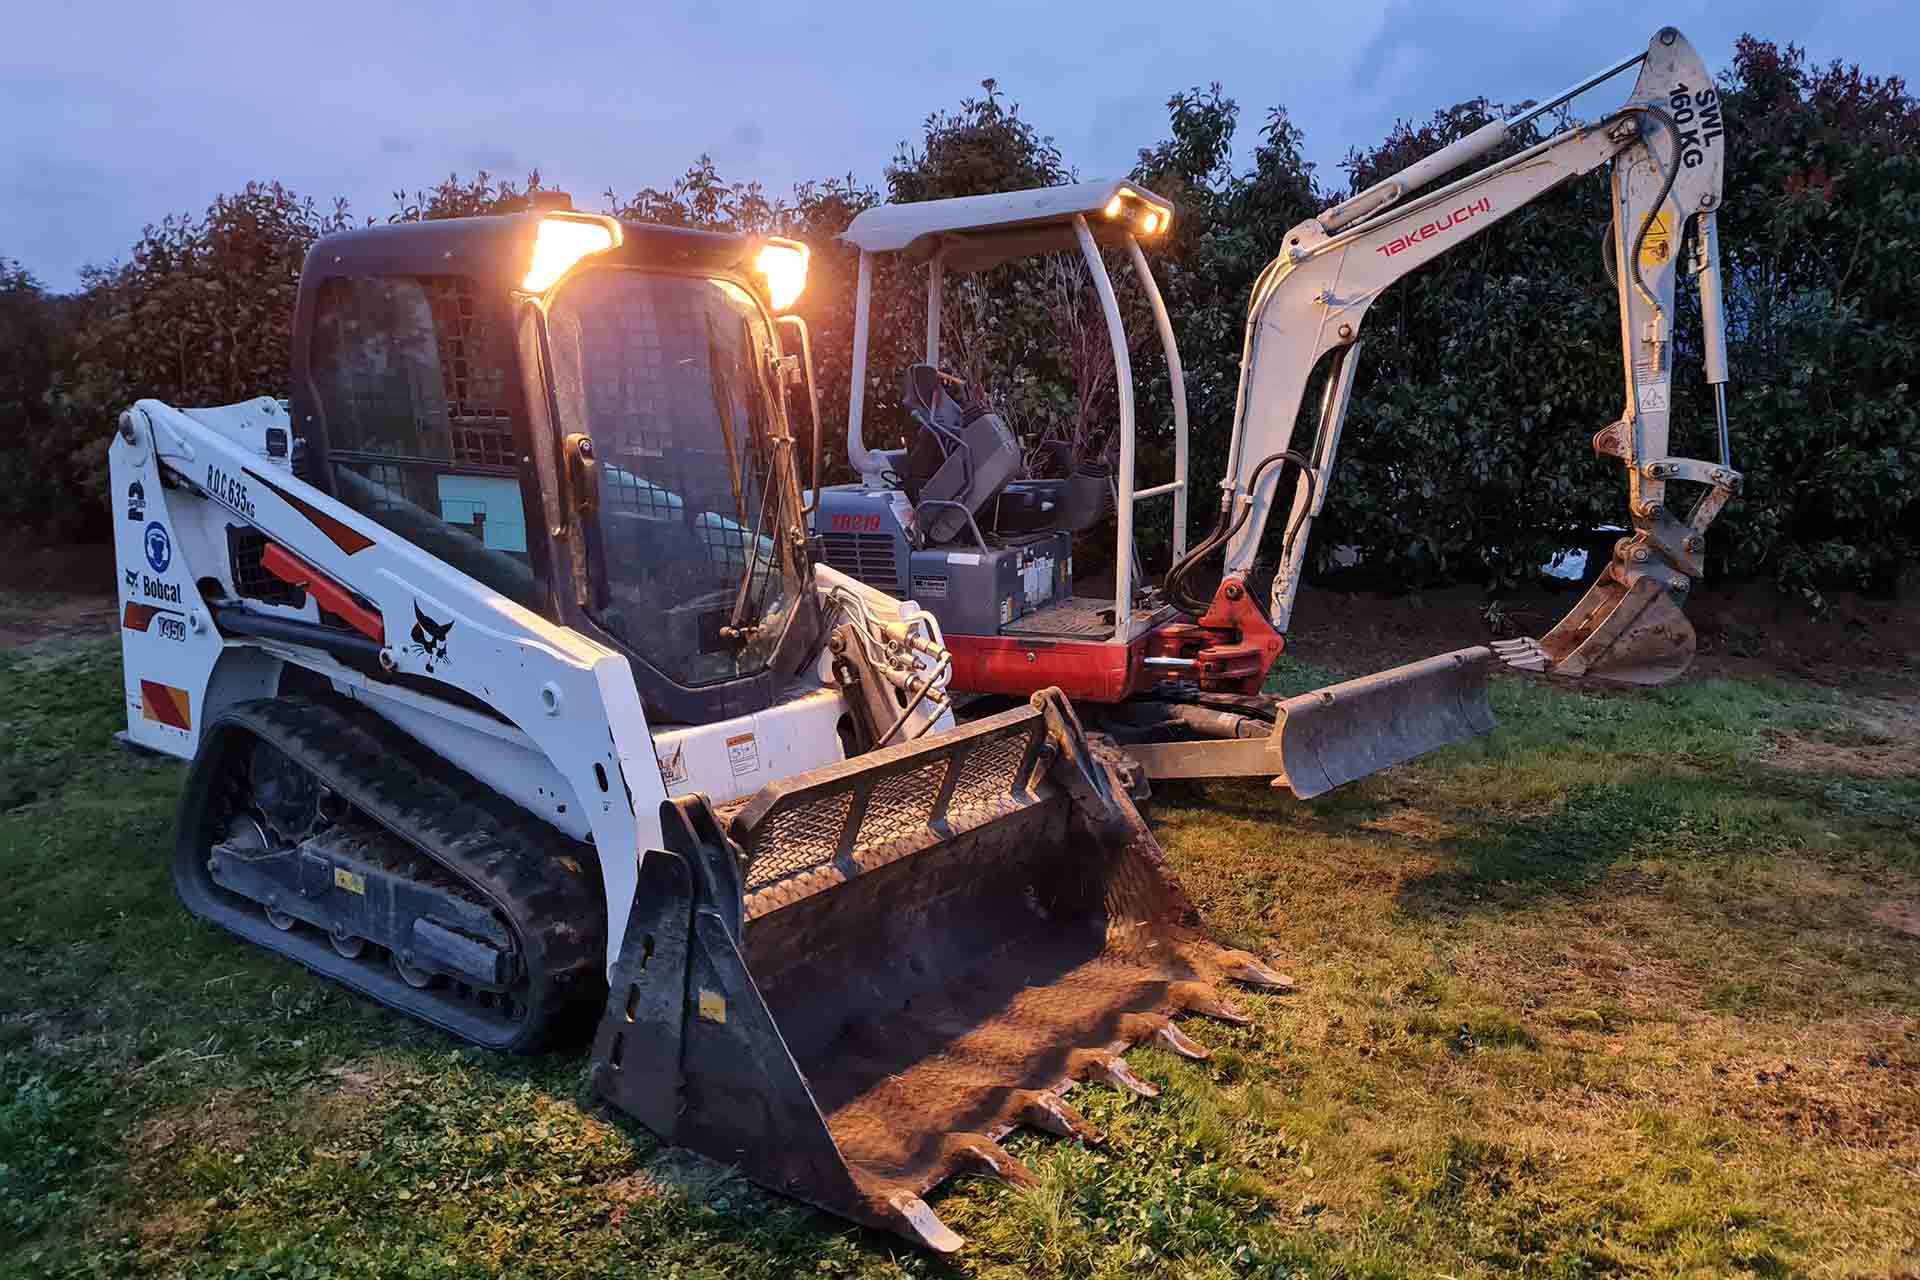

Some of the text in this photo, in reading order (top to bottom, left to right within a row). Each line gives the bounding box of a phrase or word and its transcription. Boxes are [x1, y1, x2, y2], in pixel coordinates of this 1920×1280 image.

[1669, 83, 1703, 168] 160 KG
[1695, 88, 1723, 147] SWL
[1376, 197, 1490, 256] TAKEUCHI
[143, 575, 182, 605] Bobcat
